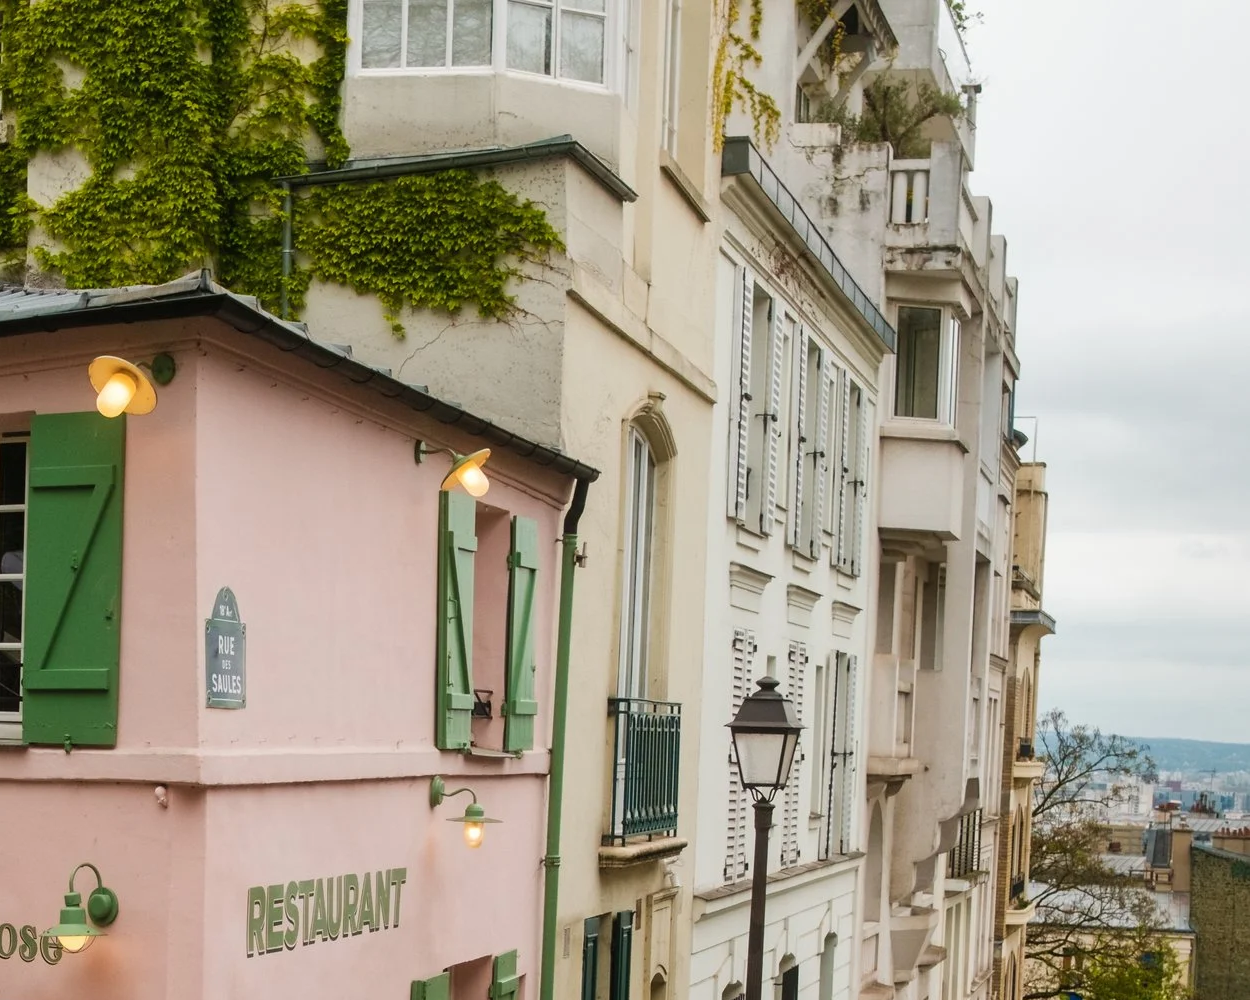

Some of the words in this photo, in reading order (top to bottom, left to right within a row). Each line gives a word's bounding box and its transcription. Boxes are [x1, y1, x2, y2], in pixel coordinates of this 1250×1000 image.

[218, 635, 235, 656] RUE
[221, 660, 231, 670] DES
[211, 673, 242, 694] SAULES
[246, 867, 407, 959] RESTAURANT
